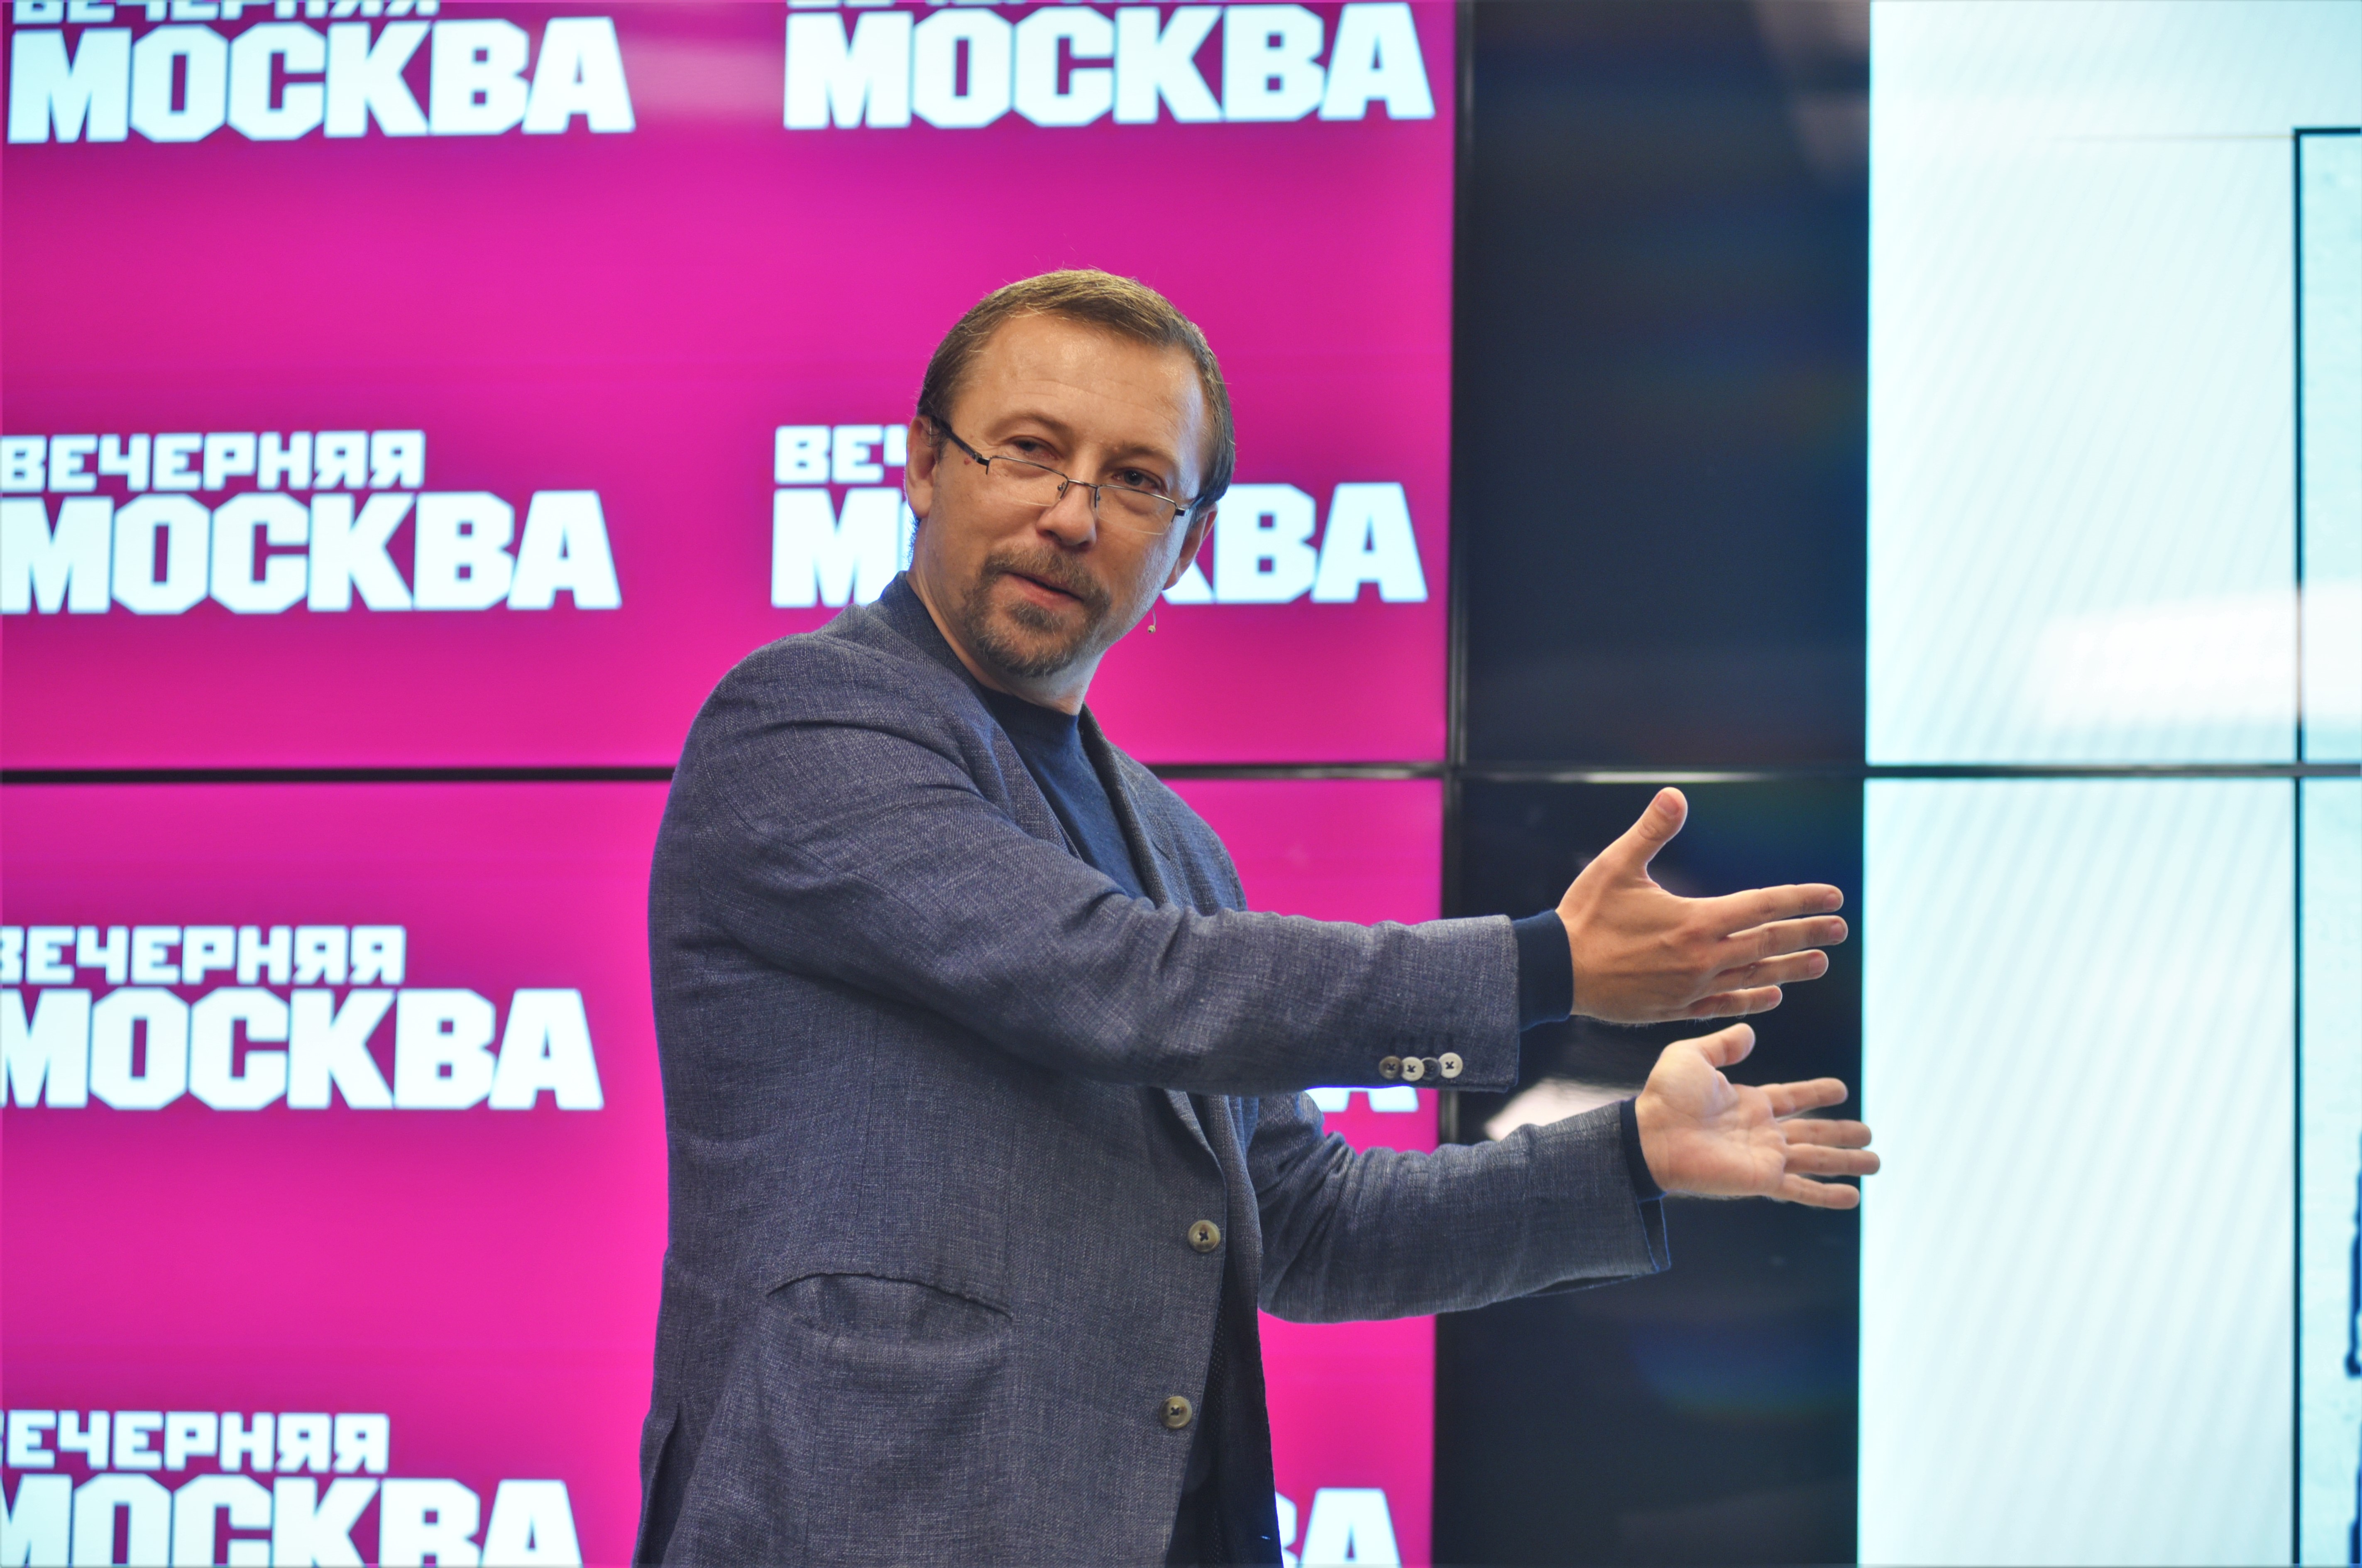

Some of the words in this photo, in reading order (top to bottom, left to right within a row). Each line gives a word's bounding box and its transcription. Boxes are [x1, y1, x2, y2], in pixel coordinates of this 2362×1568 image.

[7, 16, 636, 144] МОСКВА
[782, 1, 1436, 130] МОСКВА
[0, 430, 426, 493] ВЕЧЕРНЯЯ
[0, 490, 623, 615] МОСКВА
[770, 482, 1428, 612] МВА
[0, 986, 605, 1111] МОСКВА
[0, 1409, 391, 1474] ЕЧЕРНЯЯ
